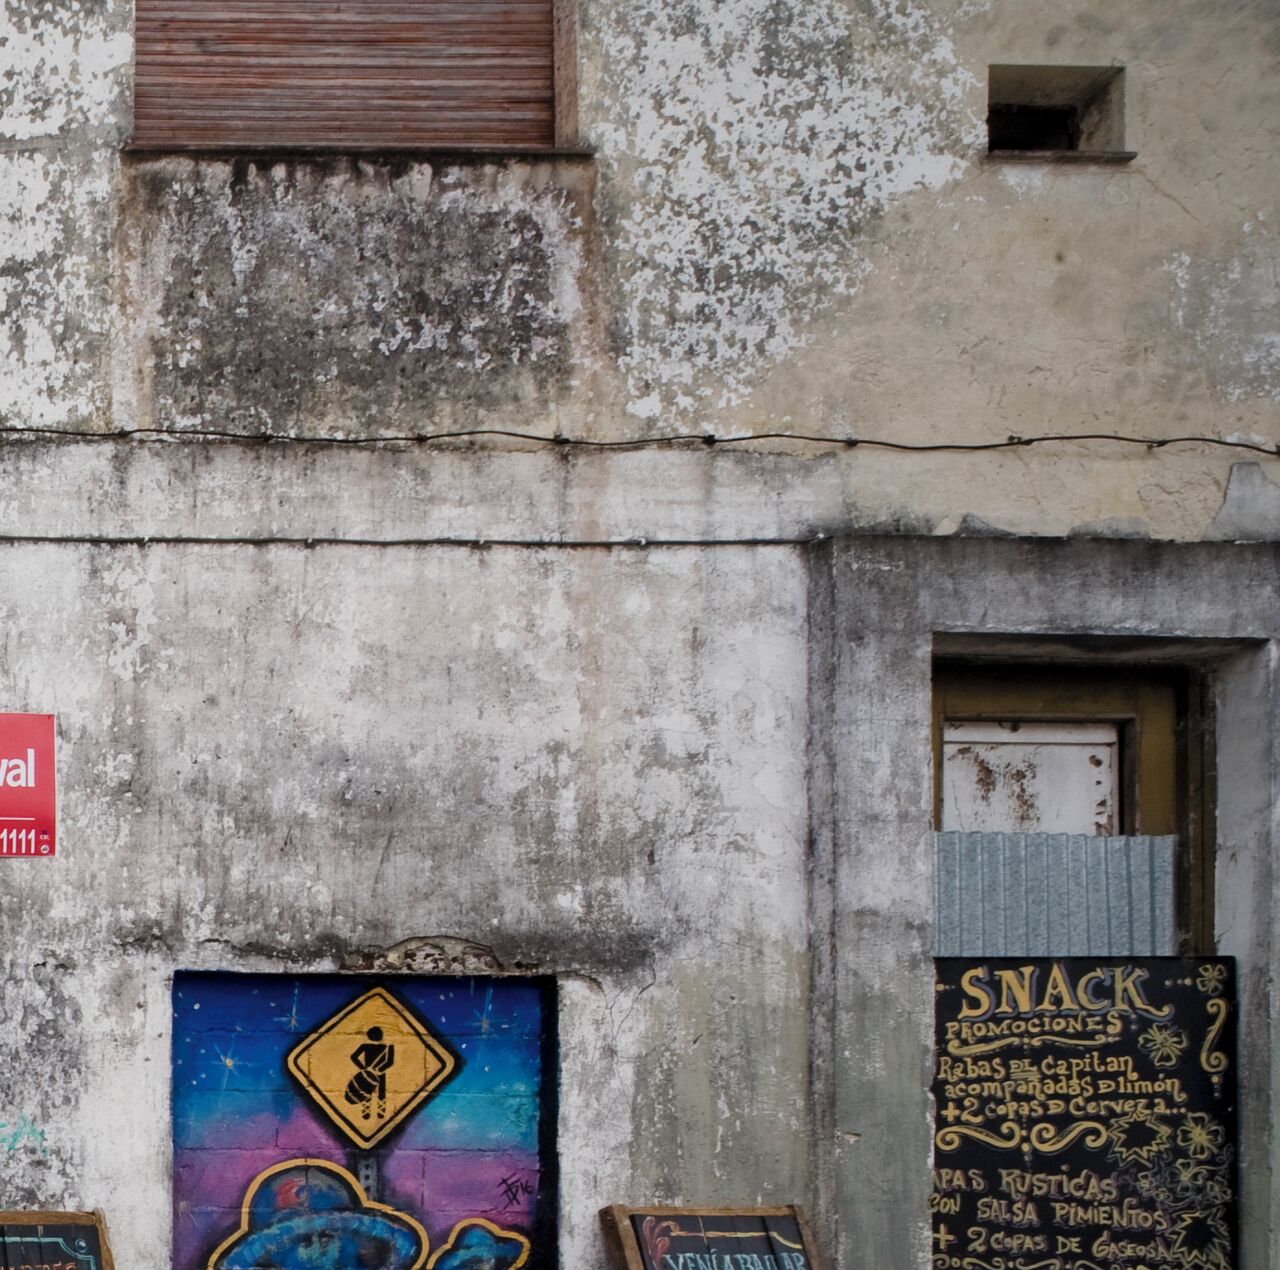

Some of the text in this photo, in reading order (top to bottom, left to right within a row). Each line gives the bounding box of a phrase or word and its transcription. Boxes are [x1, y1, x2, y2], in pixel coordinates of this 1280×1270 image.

[0, 828, 36, 854] 1111
[958, 962, 1175, 1021] SNACK
[945, 1011, 1122, 1044] PROMOCIONES
[937, 1056, 1006, 1083] Rabas
[1041, 1051, 1139, 1081] Capitan
[944, 1075, 1094, 1101] acompañadas
[977, 1195, 1039, 1225] SALSA
[967, 1226, 987, 1251] 2
[1056, 1235, 1083, 1254] DE
